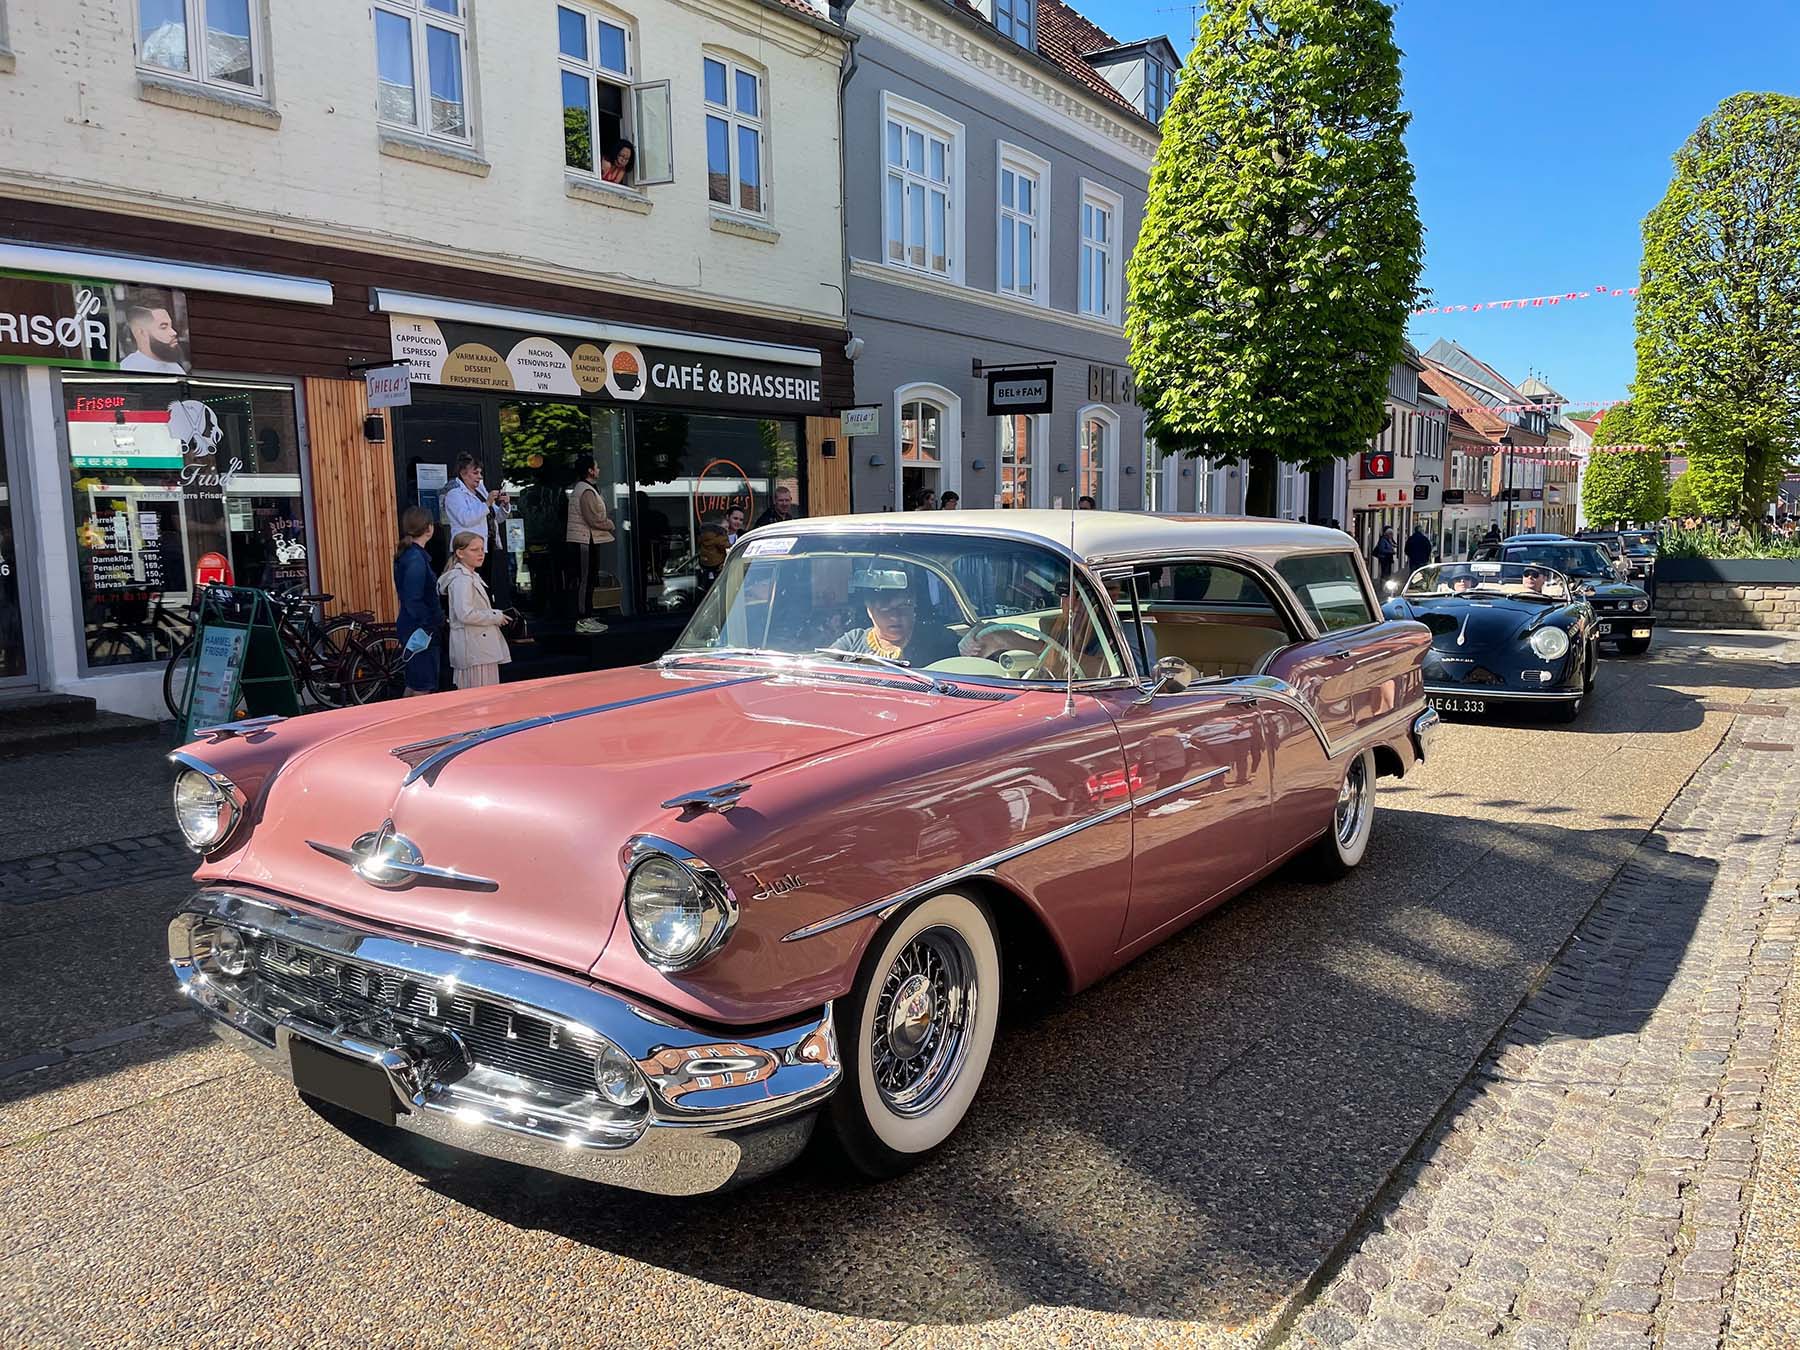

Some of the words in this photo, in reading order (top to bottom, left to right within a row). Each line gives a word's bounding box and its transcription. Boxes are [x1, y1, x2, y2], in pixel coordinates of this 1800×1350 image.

[396, 334, 441, 346] CAPPUCCINO
[402, 347, 437, 357] ESPRESSO
[528, 349, 553, 358] NACHOS
[456, 353, 475, 361] VARM
[476, 355, 498, 363] KAKAO
[409, 360, 431, 368] KAFFE
[464, 365, 492, 373] DESSERT
[517, 359, 549, 367] STENOVNS
[549, 361, 567, 369] PIZZA
[575, 364, 605, 372] SANDWICH
[533, 371, 551, 379] TAPAS
[582, 375, 599, 383] SALAT
[369, 376, 409, 398] SHIELA'S
[491, 378, 509, 386] JUICE
[651, 363, 704, 391] CAFÉ
[708, 369, 723, 393] &
[727, 371, 821, 402] BRASSERIE
[76, 396, 126, 413] Friseur
[1444, 698, 1485, 713] 61.333
